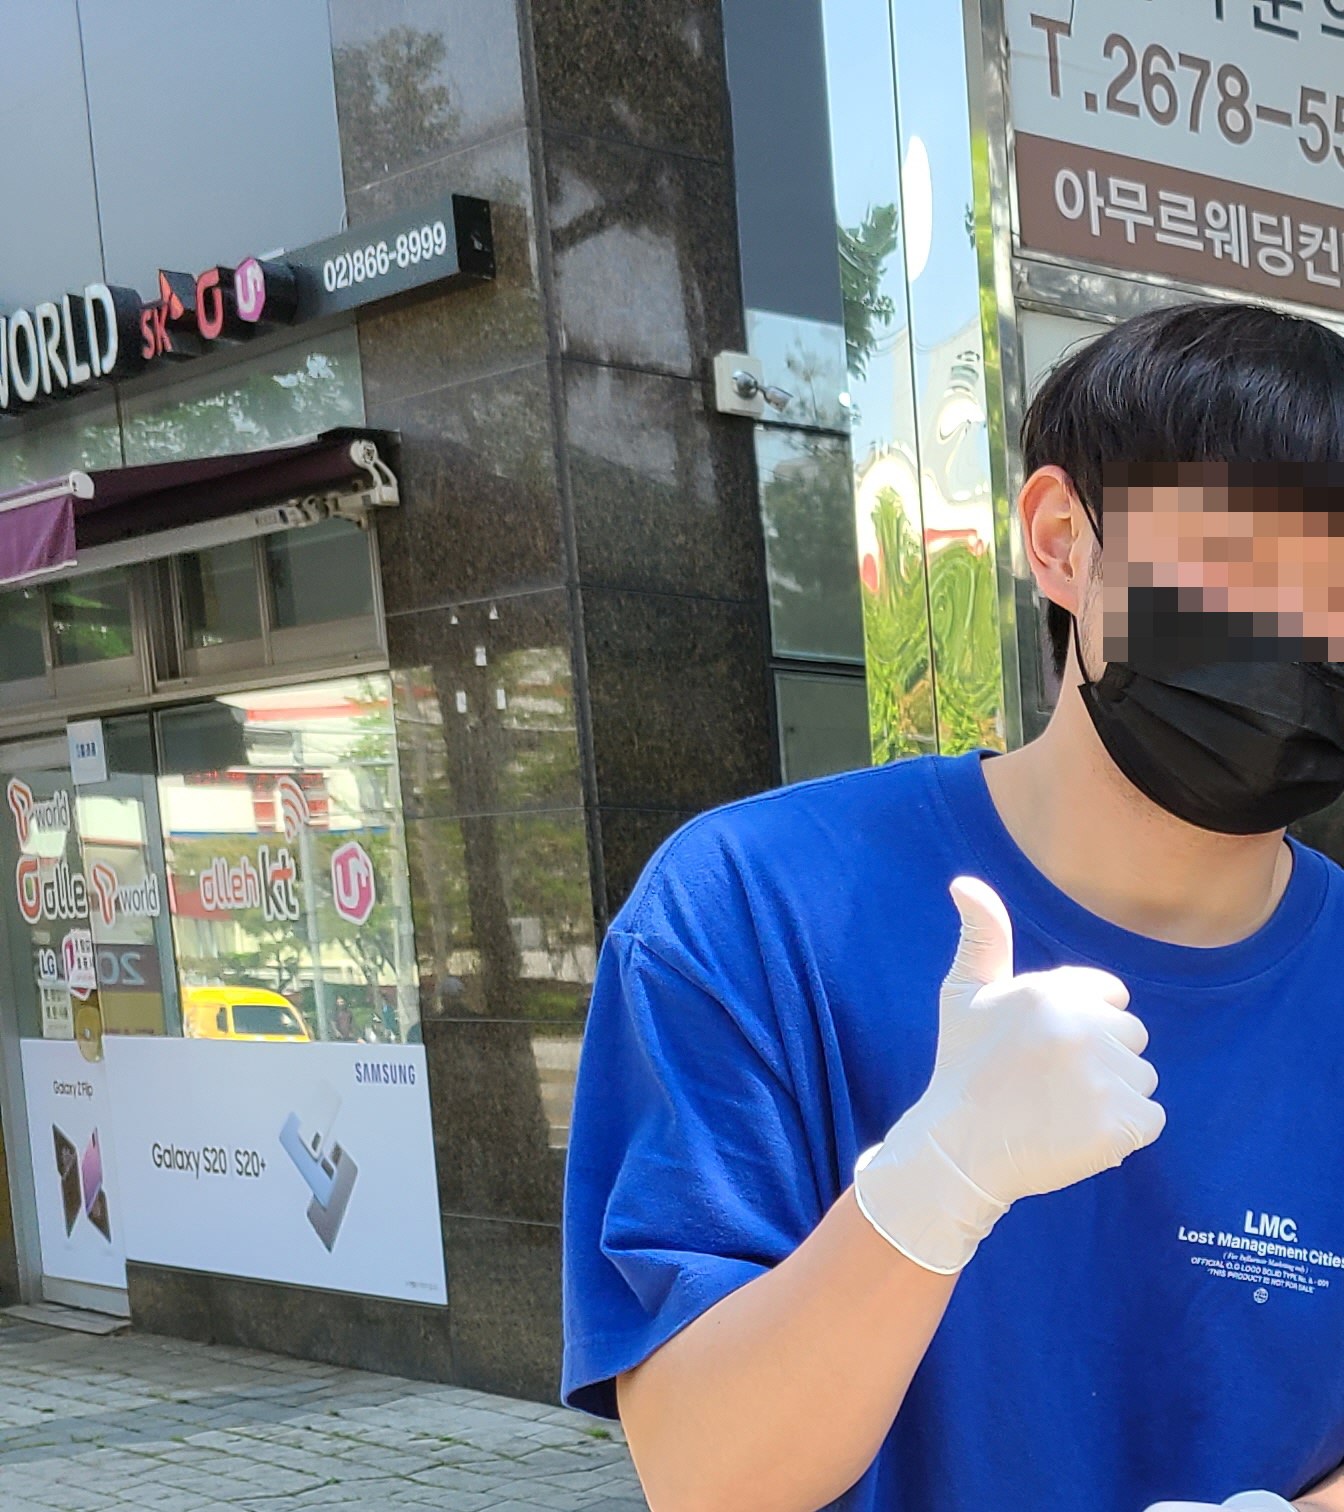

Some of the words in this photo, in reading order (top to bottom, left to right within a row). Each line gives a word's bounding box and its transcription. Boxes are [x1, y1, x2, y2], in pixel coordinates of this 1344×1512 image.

[323, 219, 447, 293] 02)866-8999
[201, 858, 260, 907] olleh
[355, 1061, 416, 1086] SAMSUNG
[152, 1143, 200, 1180] Galaxy
[203, 1147, 228, 1175] S20
[235, 1149, 266, 1178] S20+
[1178, 1226, 1215, 1245] Lost
[1217, 1231, 1308, 1262] Management
